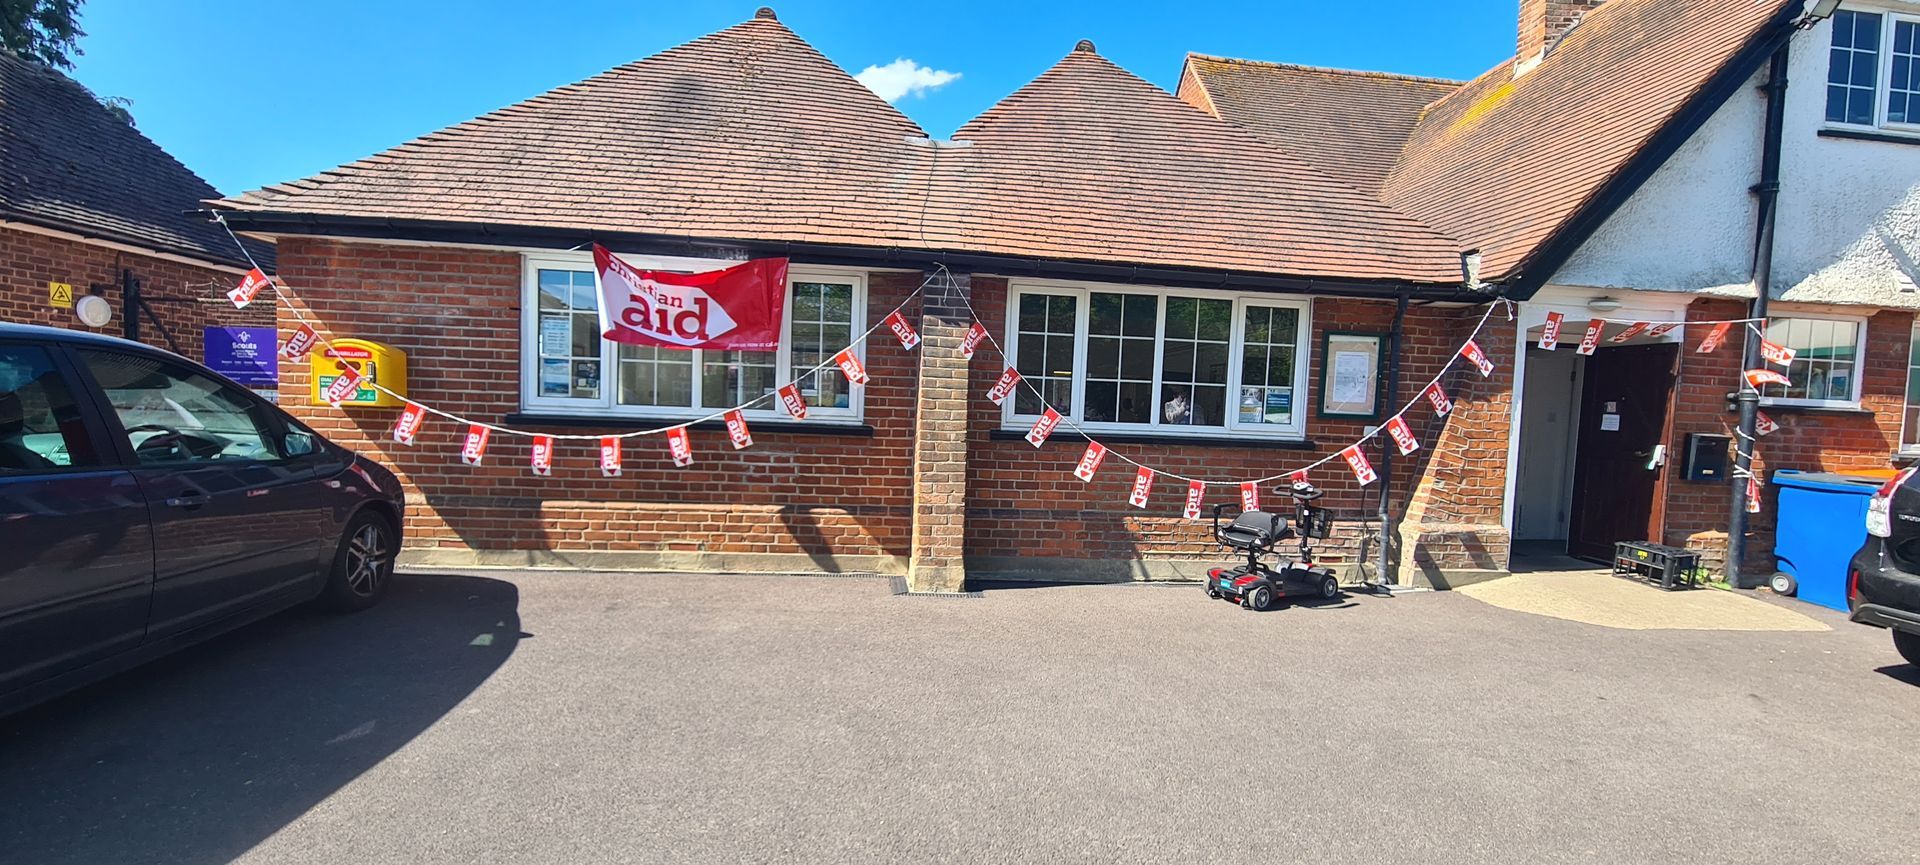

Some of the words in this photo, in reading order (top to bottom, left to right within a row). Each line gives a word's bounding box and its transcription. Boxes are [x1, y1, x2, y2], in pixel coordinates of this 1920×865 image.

[240, 275, 255, 301] aid
[608, 254, 683, 308] christian
[621, 294, 709, 340] aid
[891, 322, 915, 343] aid
[963, 328, 978, 352] aid
[1543, 320, 1554, 342] aid
[1582, 326, 1596, 348] aid
[287, 330, 307, 356] aid
[1762, 345, 1782, 361] aid
[841, 360, 864, 380] aid
[1469, 351, 1487, 368] aid
[329, 374, 351, 400] aid
[995, 373, 1012, 399] aid
[784, 395, 805, 415] aid
[1428, 391, 1447, 410] aid
[399, 411, 415, 436] aid
[729, 420, 749, 442] aid
[1034, 415, 1051, 439] aid
[466, 433, 480, 457] aid
[669, 437, 688, 459] aid
[1392, 427, 1411, 447] aid
[533, 444, 548, 468] aid
[602, 446, 618, 469] aid
[1081, 448, 1097, 473] aid
[1351, 456, 1370, 475] aid
[1136, 475, 1147, 498] aid
[1188, 488, 1201, 510] aid
[1243, 490, 1257, 512] aid
